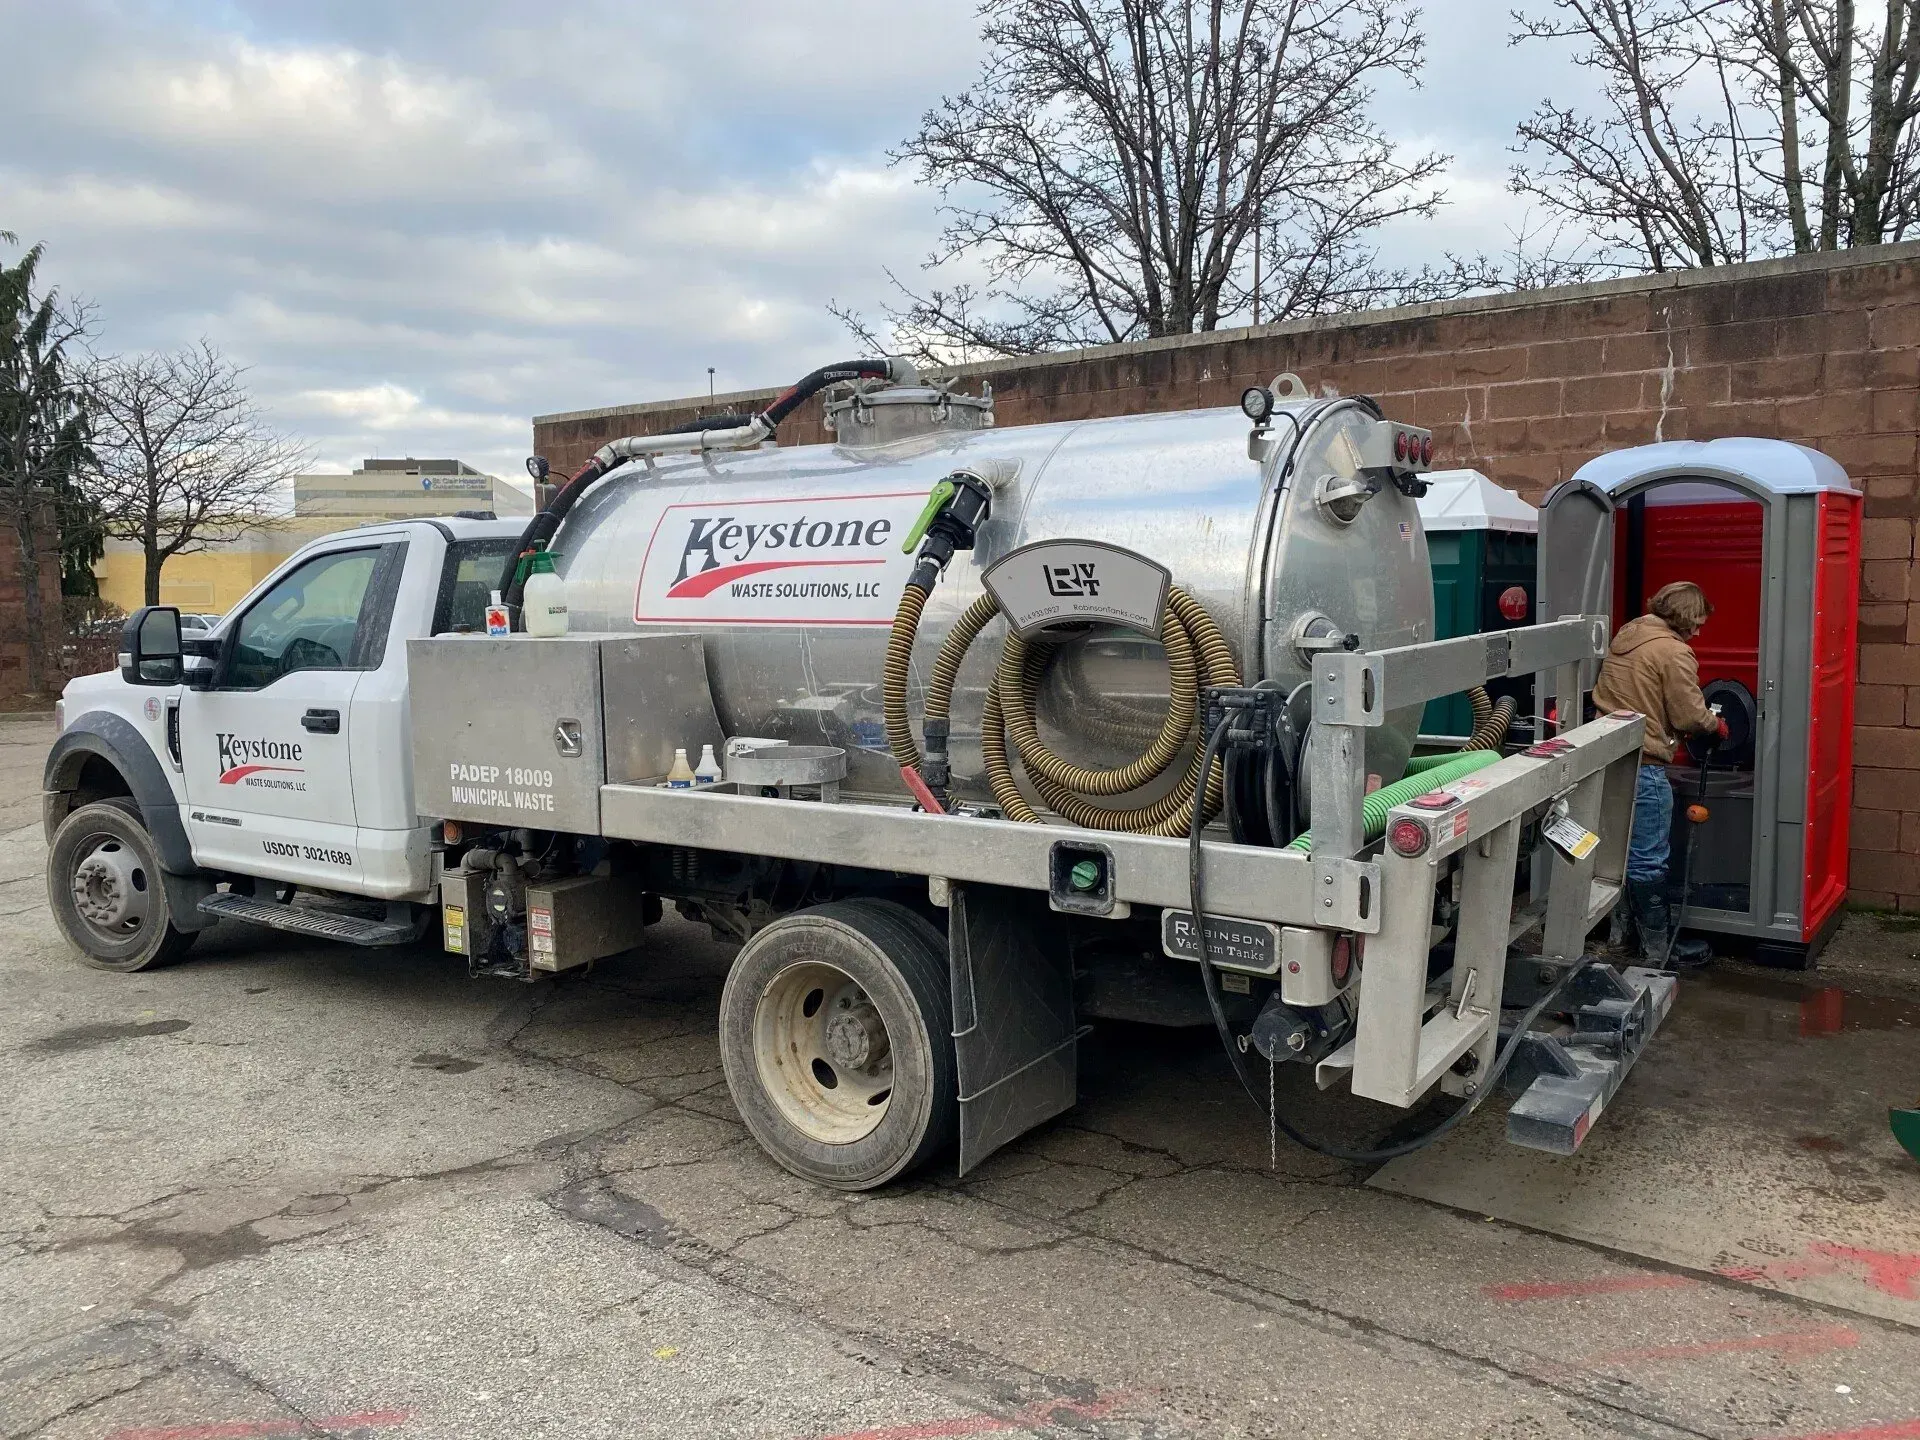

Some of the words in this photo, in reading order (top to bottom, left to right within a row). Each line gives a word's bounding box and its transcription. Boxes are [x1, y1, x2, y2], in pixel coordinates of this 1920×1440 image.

[670, 516, 891, 588] Keystone
[731, 583, 773, 597] WASTE
[775, 582, 852, 599] SOLUTIONS,
[856, 582, 880, 597] LLC
[1073, 604, 1148, 623] RobinsonTanks.com
[216, 733, 302, 777] Keystone
[245, 777, 263, 787] WASTE
[263, 779, 295, 791] SOLUTIONS,
[295, 782, 306, 791] LLC
[450, 763, 500, 783] PADEP
[505, 767, 553, 788] 18009
[451, 786, 511, 807] MUNICIPAL
[513, 791, 554, 812] WASTE
[262, 841, 299, 858] USDOT
[302, 846, 352, 866] 3021689
[1176, 937, 1223, 954] Vacum
[1226, 946, 1264, 960] Tanks
